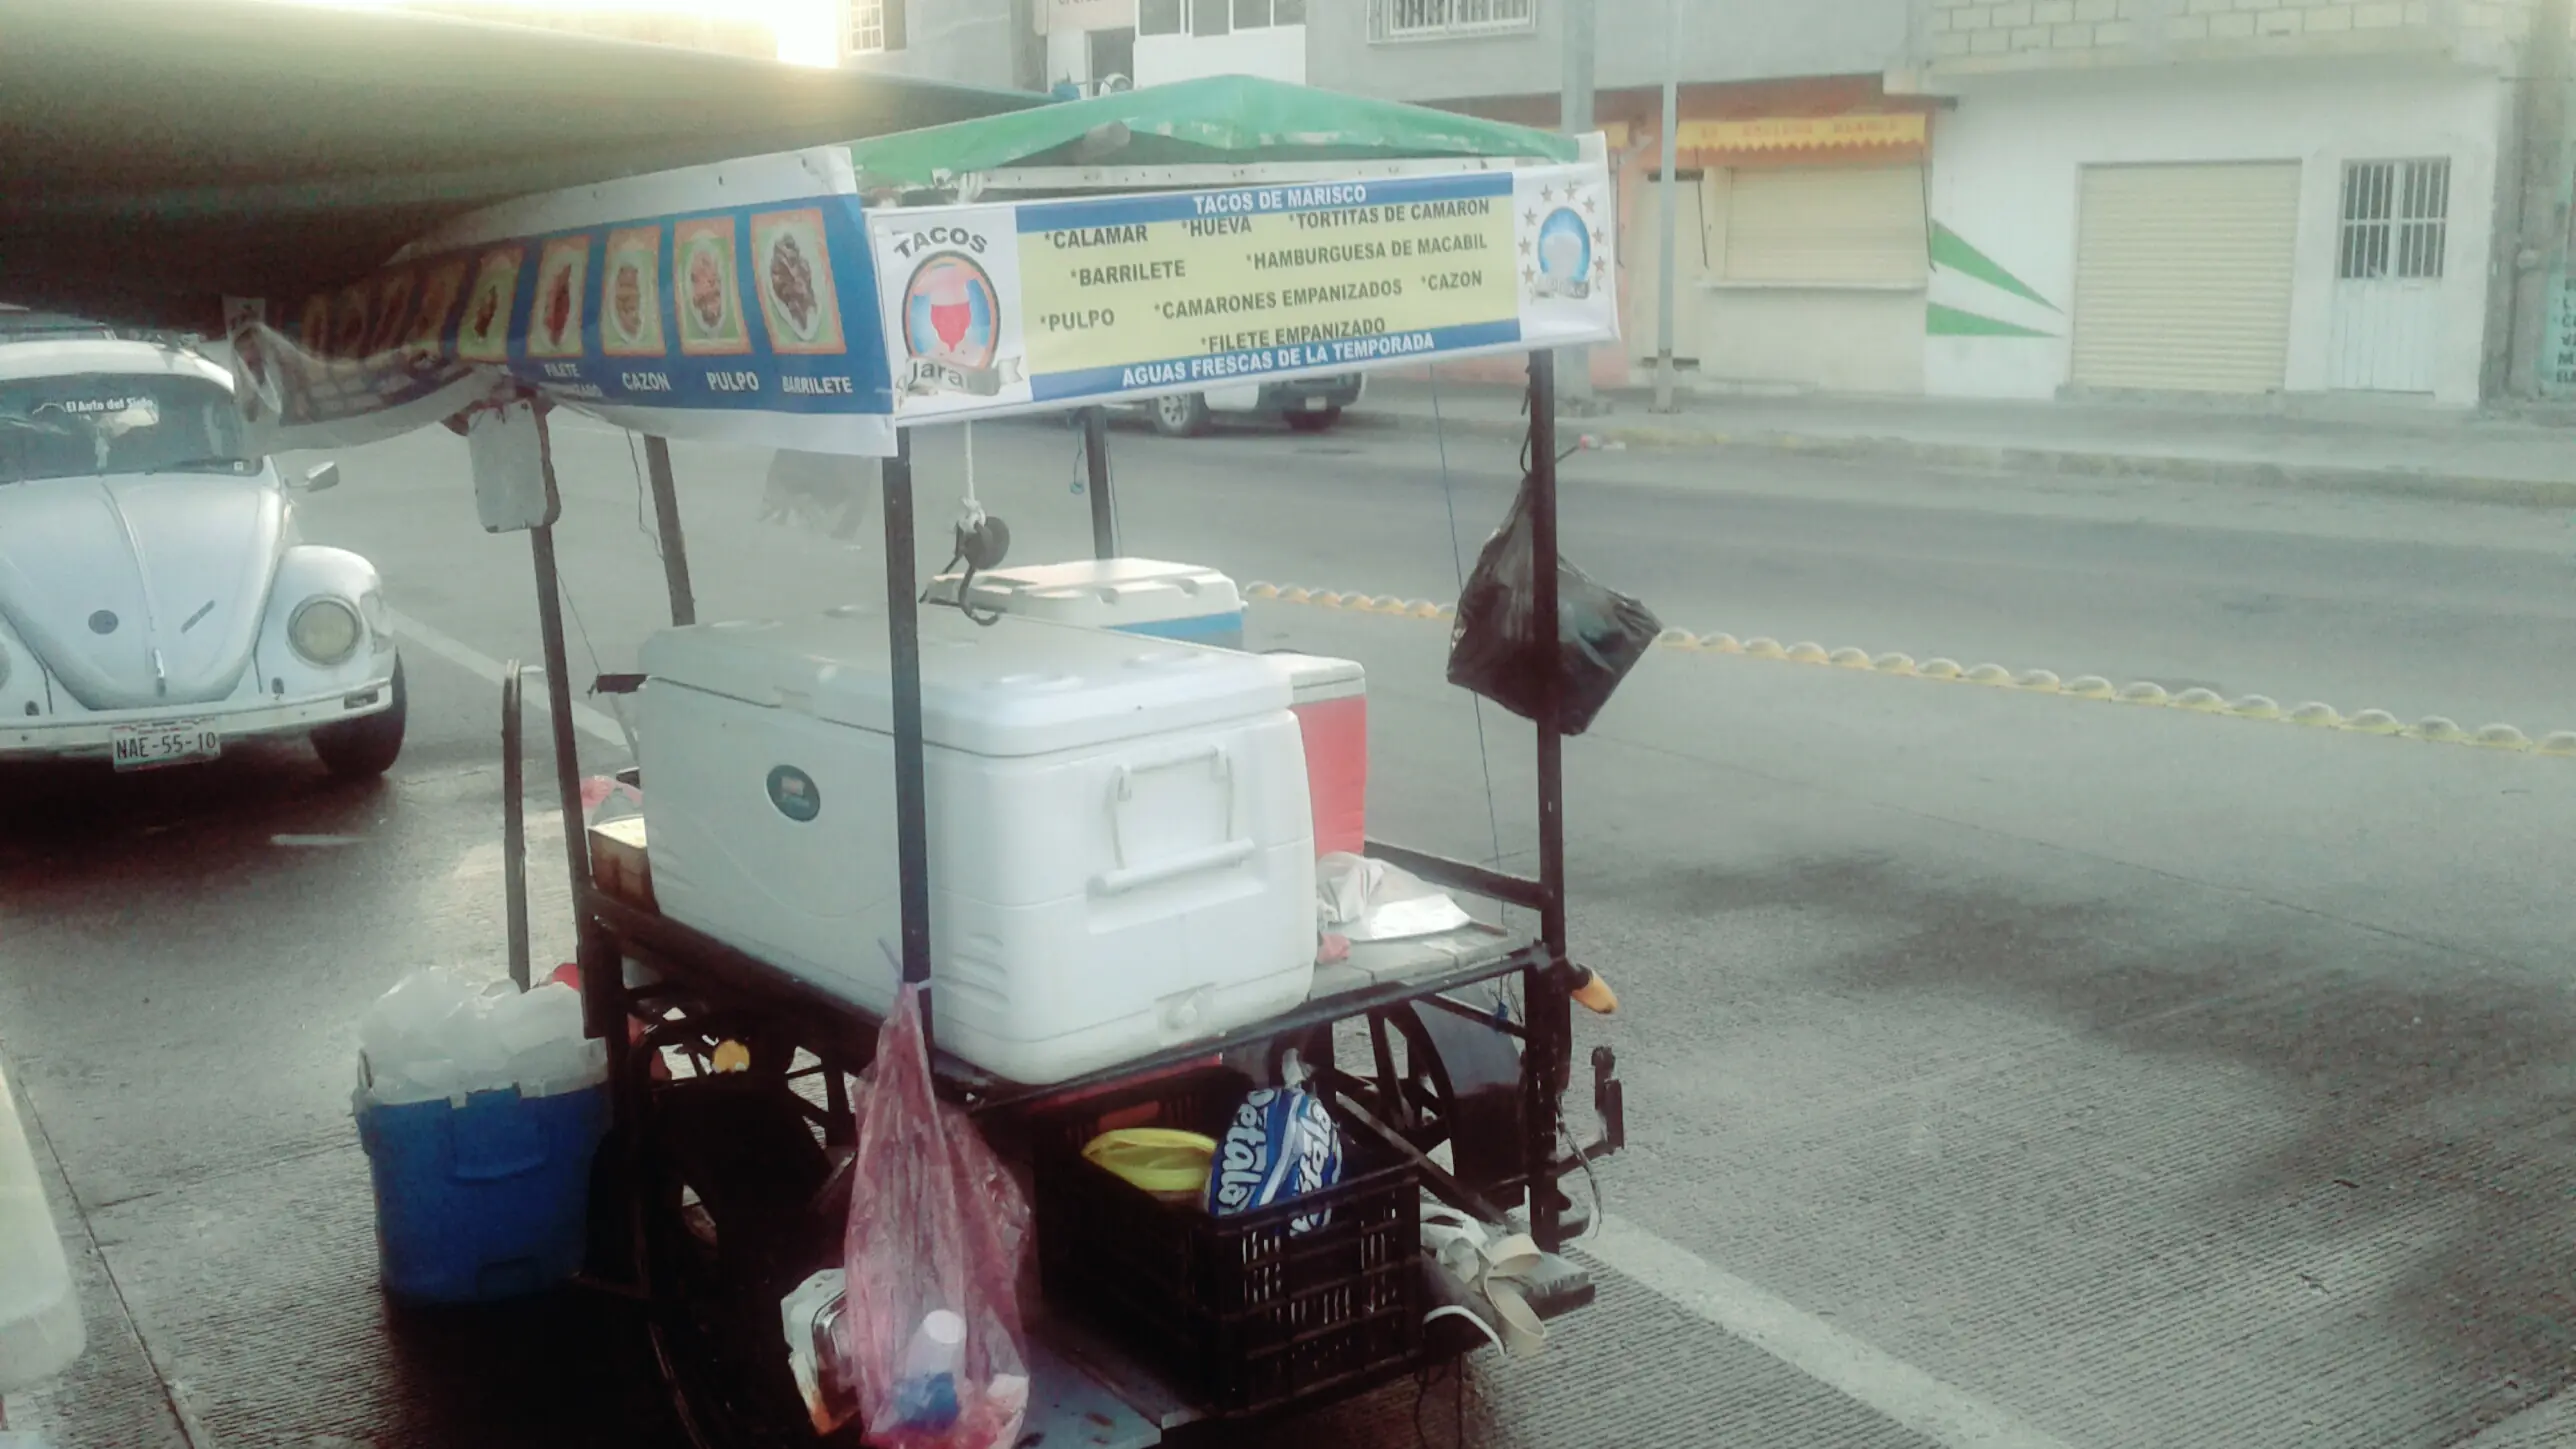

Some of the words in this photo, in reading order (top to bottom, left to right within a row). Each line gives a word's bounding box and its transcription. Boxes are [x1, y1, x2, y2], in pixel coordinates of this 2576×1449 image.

[1193, 193, 1253, 215] TACOS
[1259, 190, 1283, 210] DE
[1287, 186, 1367, 207] MARISCO
[1384, 204, 1405, 222] DE
[1411, 198, 1490, 221] CAMARON
[893, 227, 988, 260] TACOS
[1391, 239, 1412, 257] DE
[1417, 233, 1488, 255] MACABIL
[1282, 278, 1403, 308] EMPANIZADOS
[1275, 317, 1386, 346] EMPANIZADO
[1122, 359, 1186, 387] AGUAS
[1191, 350, 1273, 379] FRESCAS
[1278, 348, 1300, 367] DE
[1305, 345, 1329, 364] LA
[1333, 332, 1435, 361] TEMPORADA
[622, 371, 673, 392] CAZON
[706, 371, 760, 392] PULPO
[782, 375, 853, 395] BARRILETE
